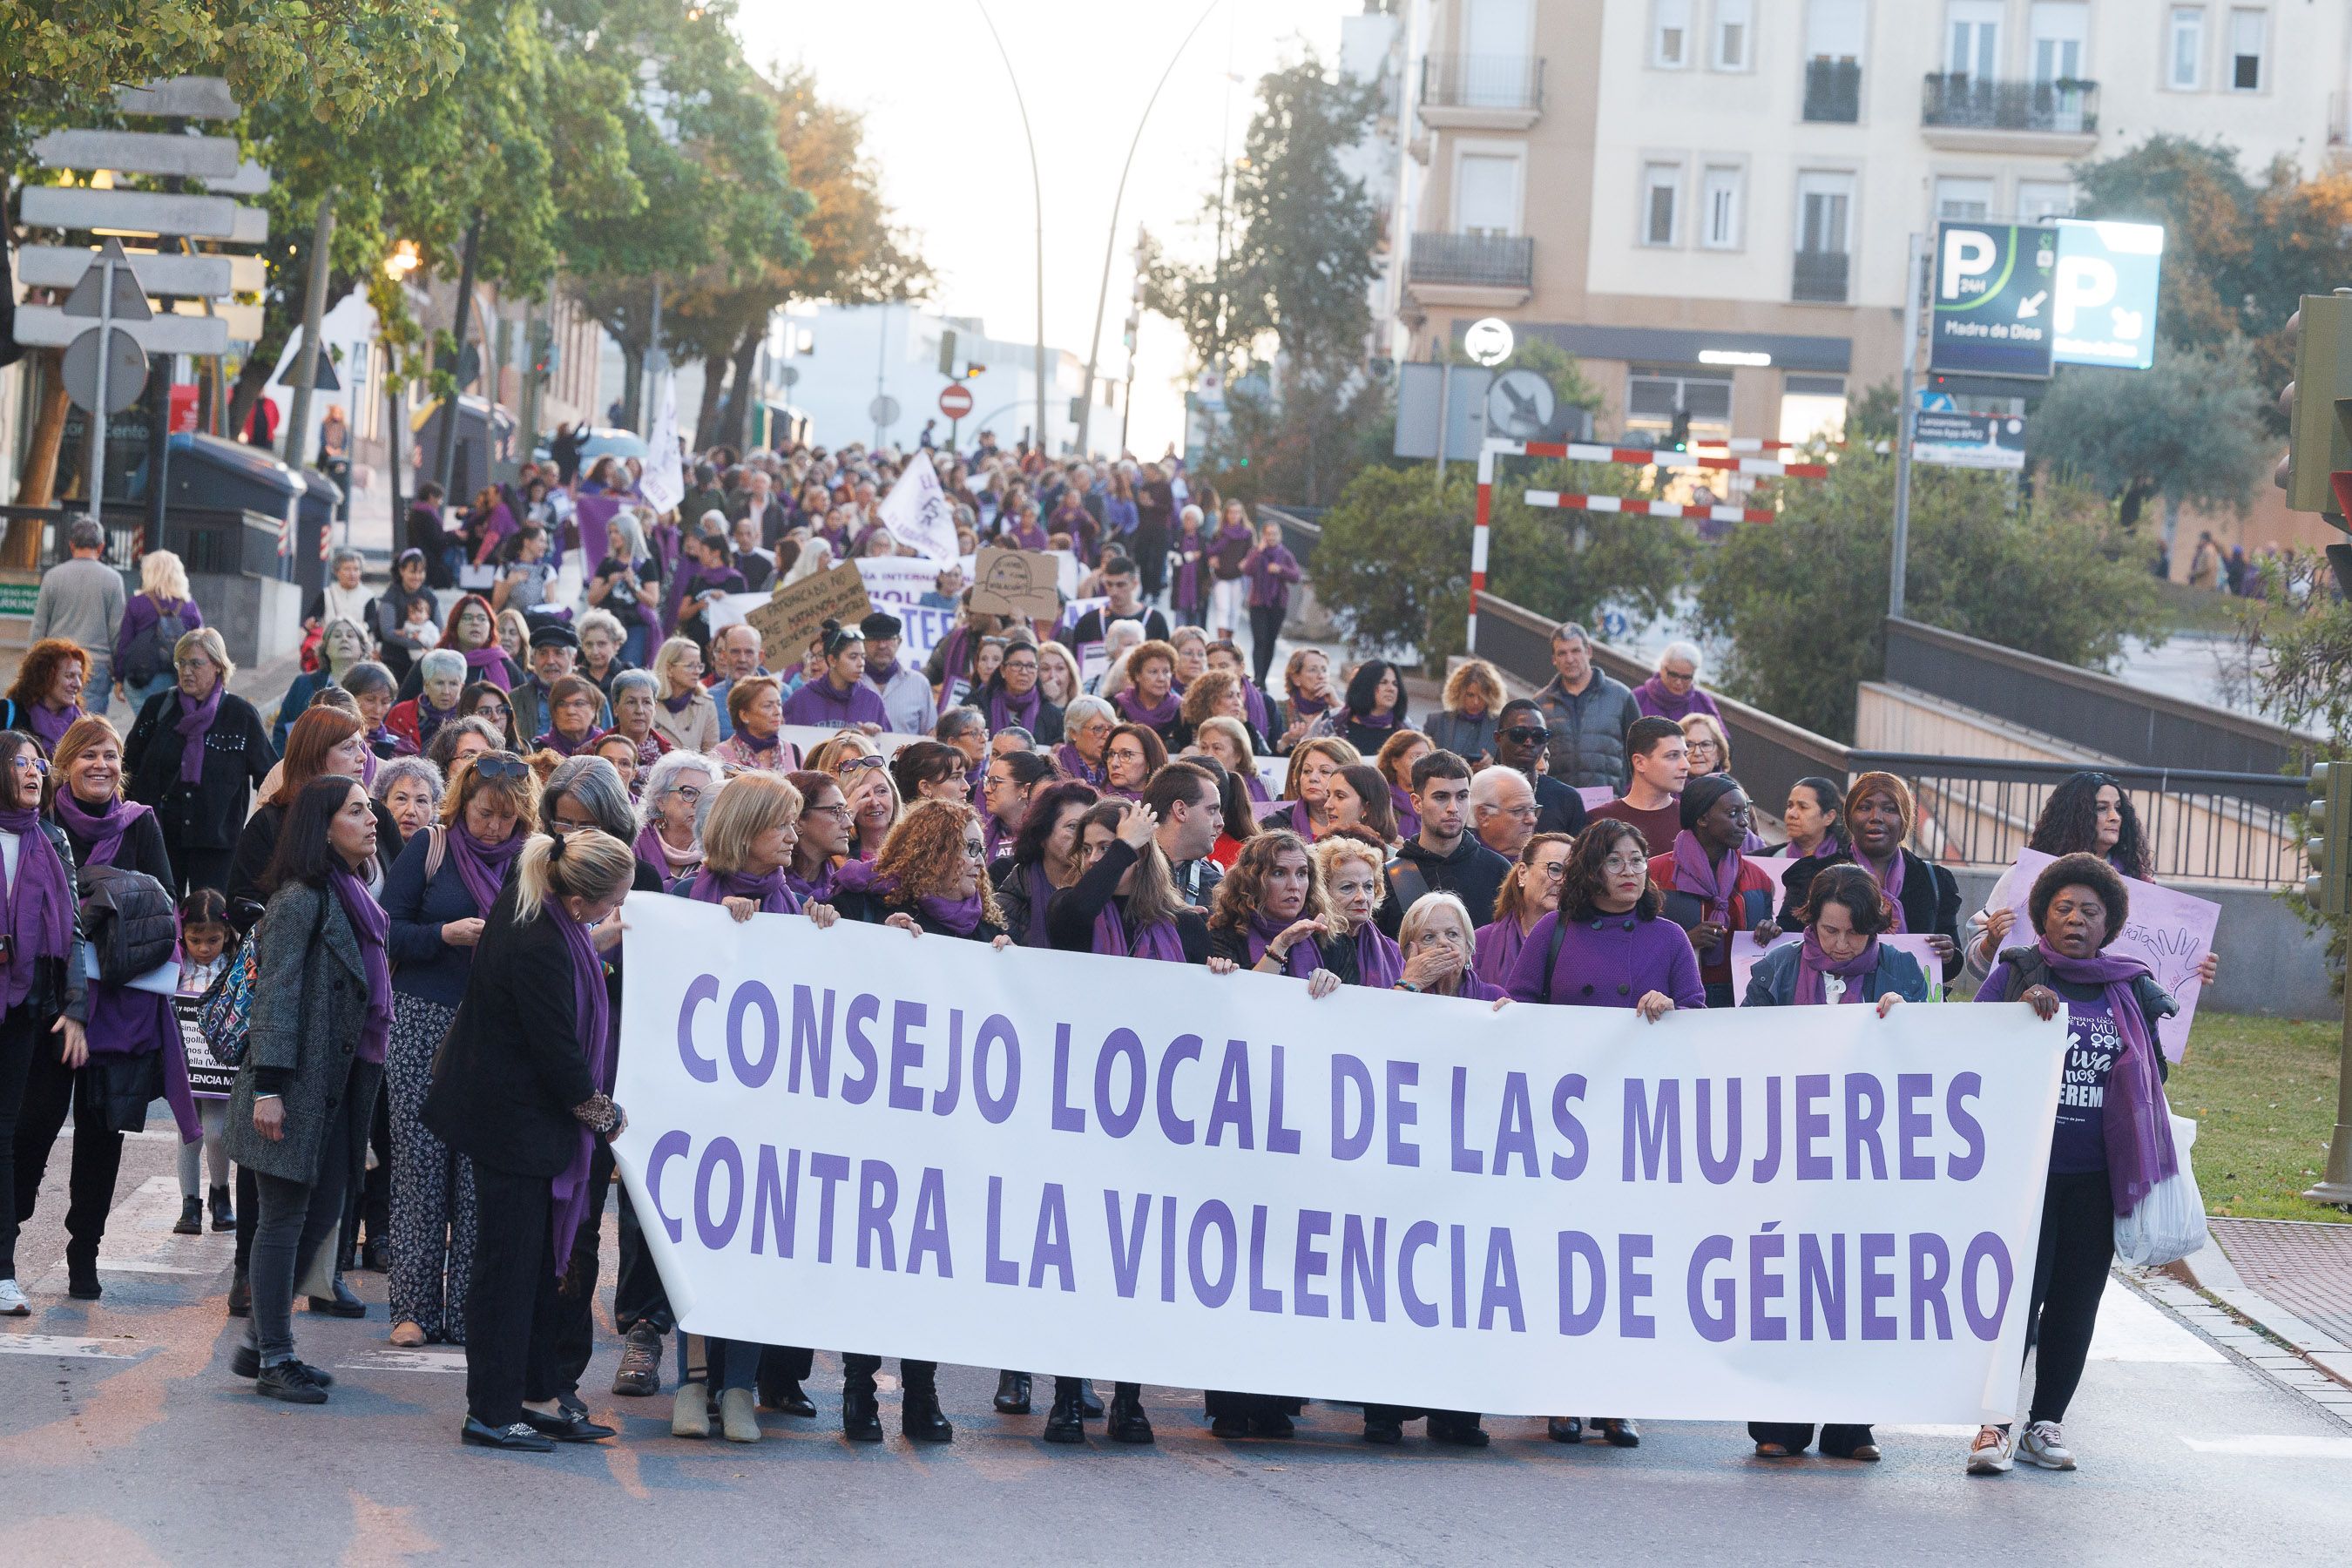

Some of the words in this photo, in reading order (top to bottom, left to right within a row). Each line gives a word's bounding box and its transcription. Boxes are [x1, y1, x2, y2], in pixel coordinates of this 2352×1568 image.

[1944, 229, 1996, 299] P
[1960, 279, 1986, 293] 24H
[2056, 256, 2117, 335] P
[1945, 320, 1989, 336] Madre
[1990, 323, 2008, 339] de
[2011, 323, 2042, 341] Dios
[184, 1036, 206, 1044] golla
[2091, 1023, 2119, 1038] MUJ
[187, 1072, 222, 1085] LENCIA
[678, 973, 1021, 1125] CONSEJO
[1051, 1022, 1301, 1155] LOCAL
[1331, 1053, 1420, 1168] DE
[1450, 1065, 1589, 1181] LAS
[1622, 1071, 1985, 1185] MUJERES
[2065, 1069, 2097, 1085] nos
[2058, 1084, 2104, 1108] EREM
[645, 1129, 953, 1279] CONTRA
[985, 1175, 1076, 1293] LA
[1103, 1189, 1526, 1333] VIOLENCIA
[1558, 1230, 1655, 1340] DE
[1686, 1220, 2014, 1343] GÉNERO
